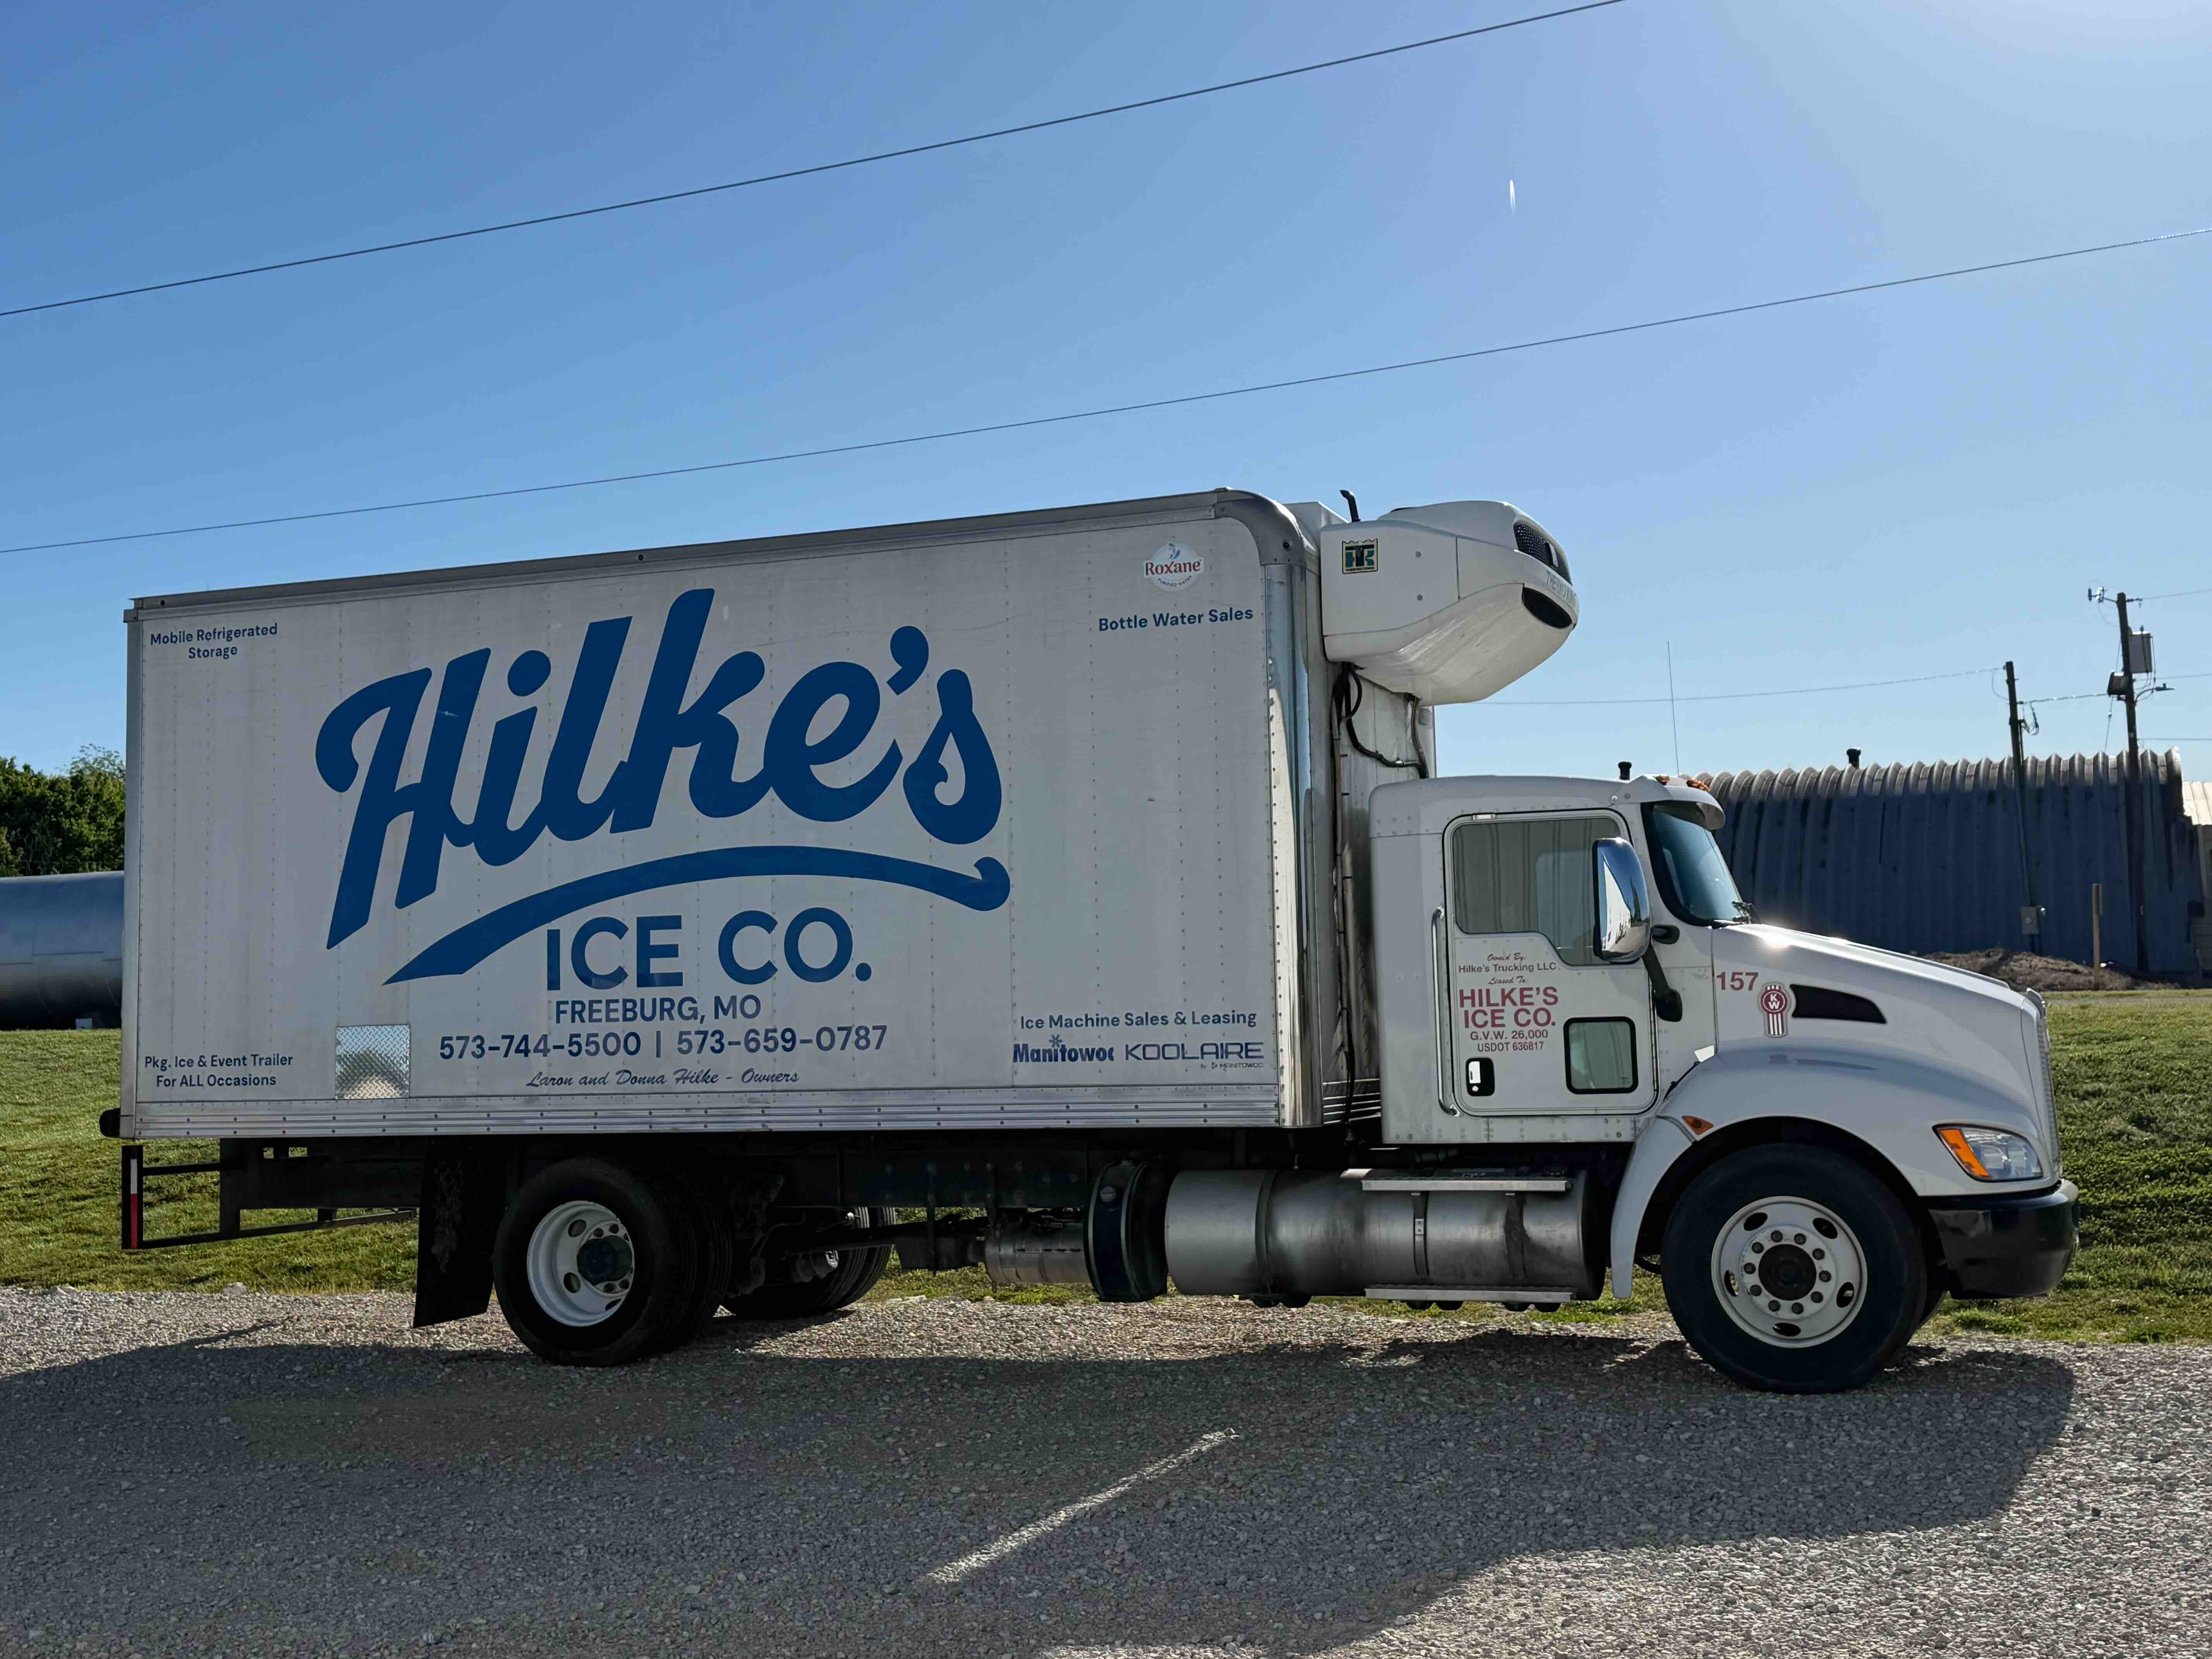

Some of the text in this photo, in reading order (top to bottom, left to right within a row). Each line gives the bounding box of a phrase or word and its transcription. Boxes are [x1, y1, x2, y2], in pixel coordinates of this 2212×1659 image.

[1145, 561, 1201, 576] Roxane
[1099, 607, 1254, 632] Bottle Water Sales
[150, 622, 278, 646] Mobile Refrigerated
[188, 645, 238, 660] Storage
[315, 587, 1002, 950] Hilke's
[546, 907, 872, 991] ICE CO.
[1459, 962, 1556, 973] Hilke's Trucking LLC
[1716, 972, 1759, 991] 157
[1459, 987, 1558, 1007] HILKE'S
[555, 994, 762, 1024] FREEBURG, MO
[1464, 1008, 1556, 1028] ICE CO.
[1021, 1010, 1257, 1029] Ice Machine Sales & Leasing
[440, 1031, 641, 1060] 573-744-5500
[677, 1024, 888, 1054] 573-659-0787
[1470, 1030, 1548, 1041] G.V.W. 26,000
[1013, 1042, 1264, 1063] Manitowoc KOOLAIRE
[1478, 1042, 1544, 1052] USDOT 636817
[145, 1053, 294, 1072] Pkg. Ice & Event Trailer
[156, 1073, 276, 1087] For ALL Occasions
[526, 1071, 573, 1087] Laron
[579, 1071, 610, 1085] and
[615, 1069, 666, 1085] Donna
[673, 1068, 720, 1084] Hilke
[741, 1067, 800, 1084] Owners
